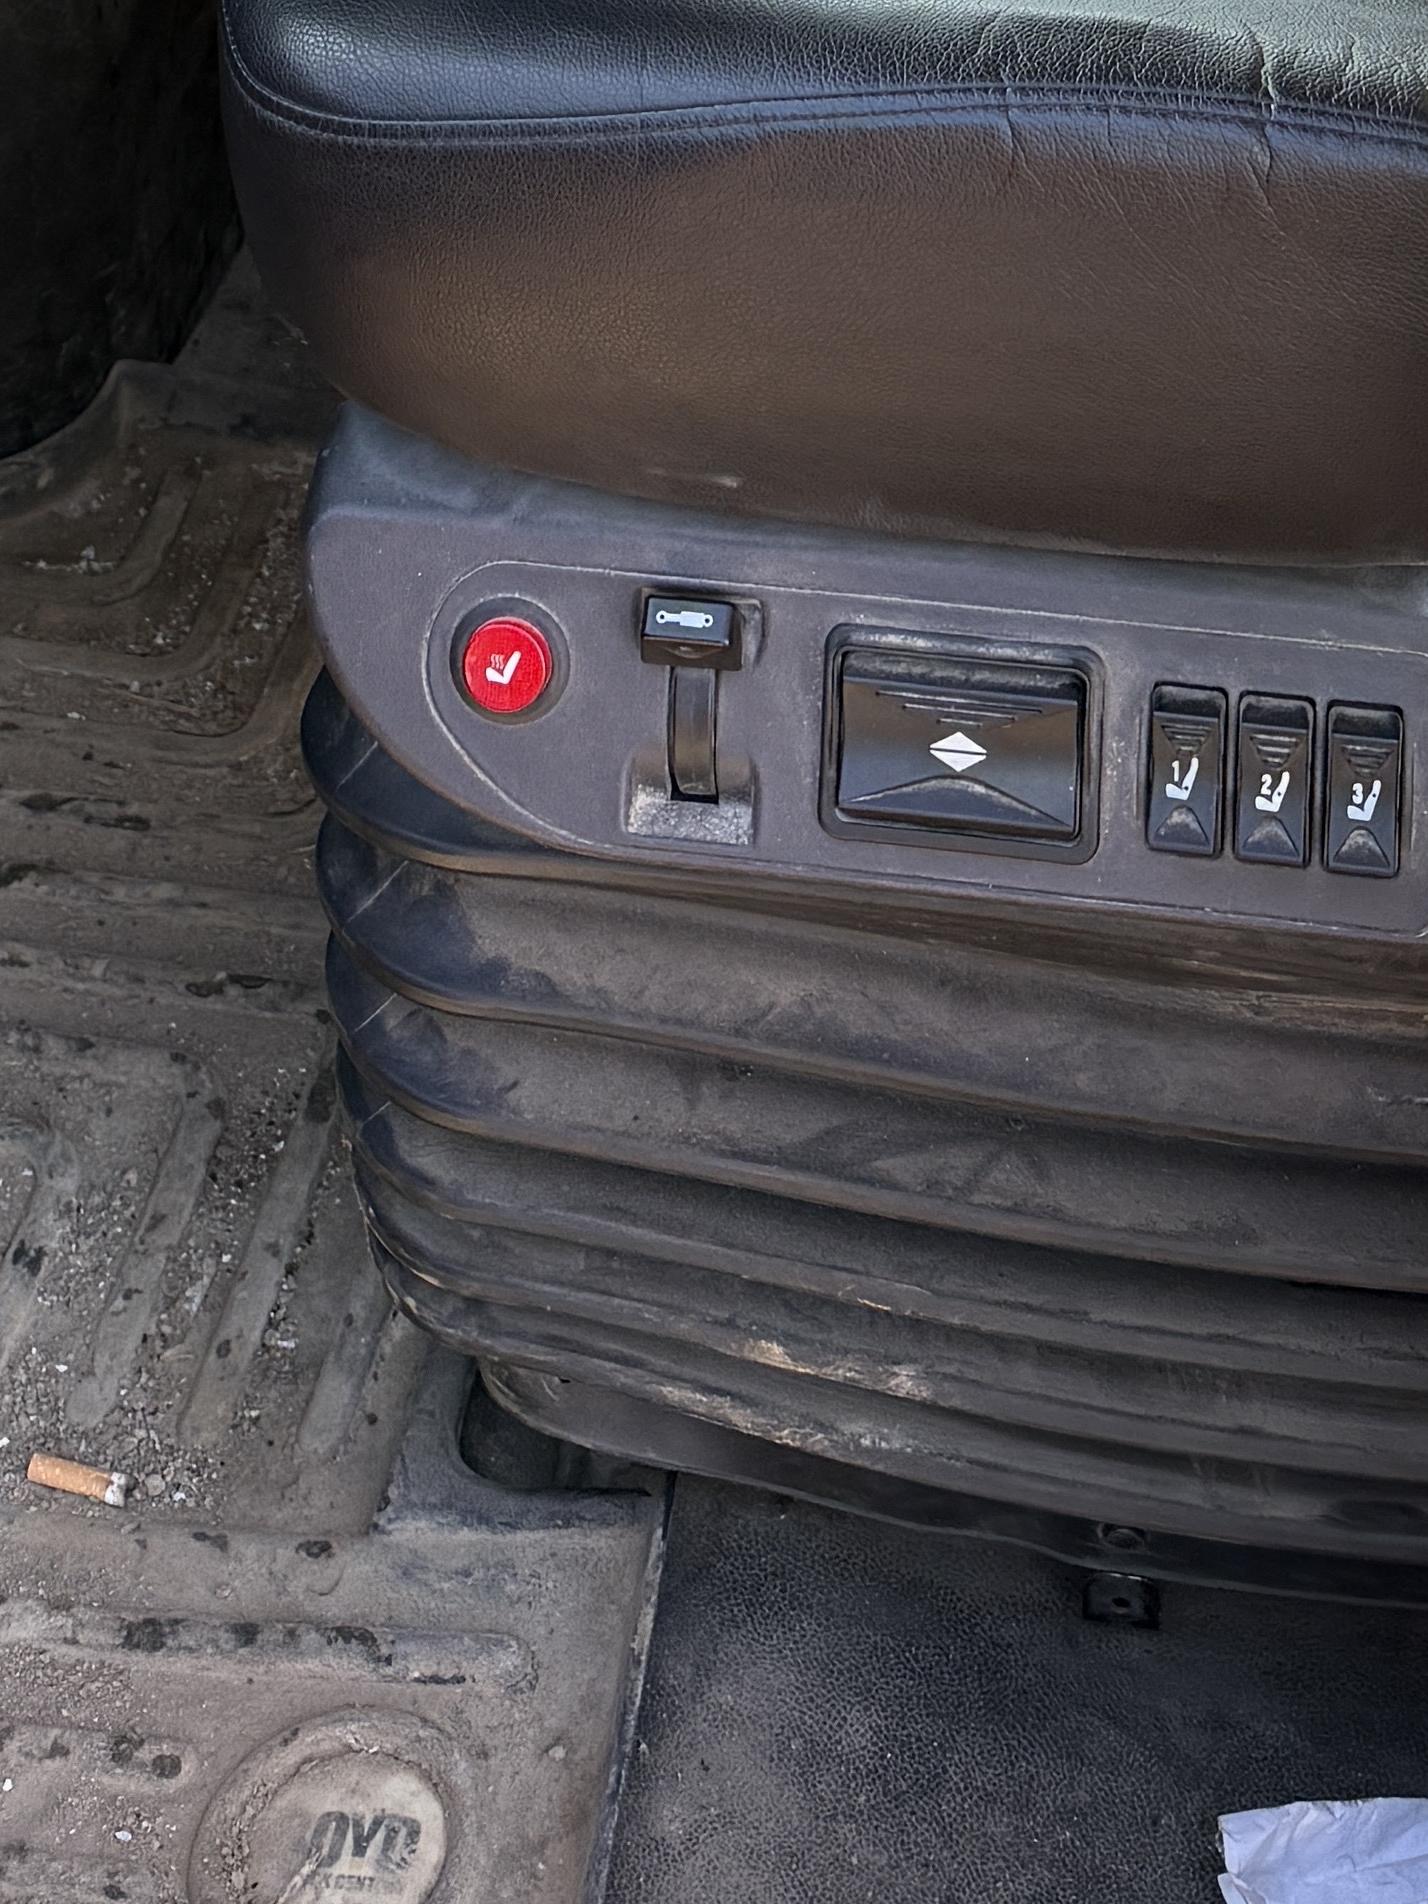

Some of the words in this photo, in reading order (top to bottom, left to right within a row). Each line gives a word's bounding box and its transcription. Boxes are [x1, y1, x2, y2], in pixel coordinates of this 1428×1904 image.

[1169, 760, 1183, 788] 1
[1258, 773, 1275, 797] 2
[1351, 782, 1367, 806] 3
